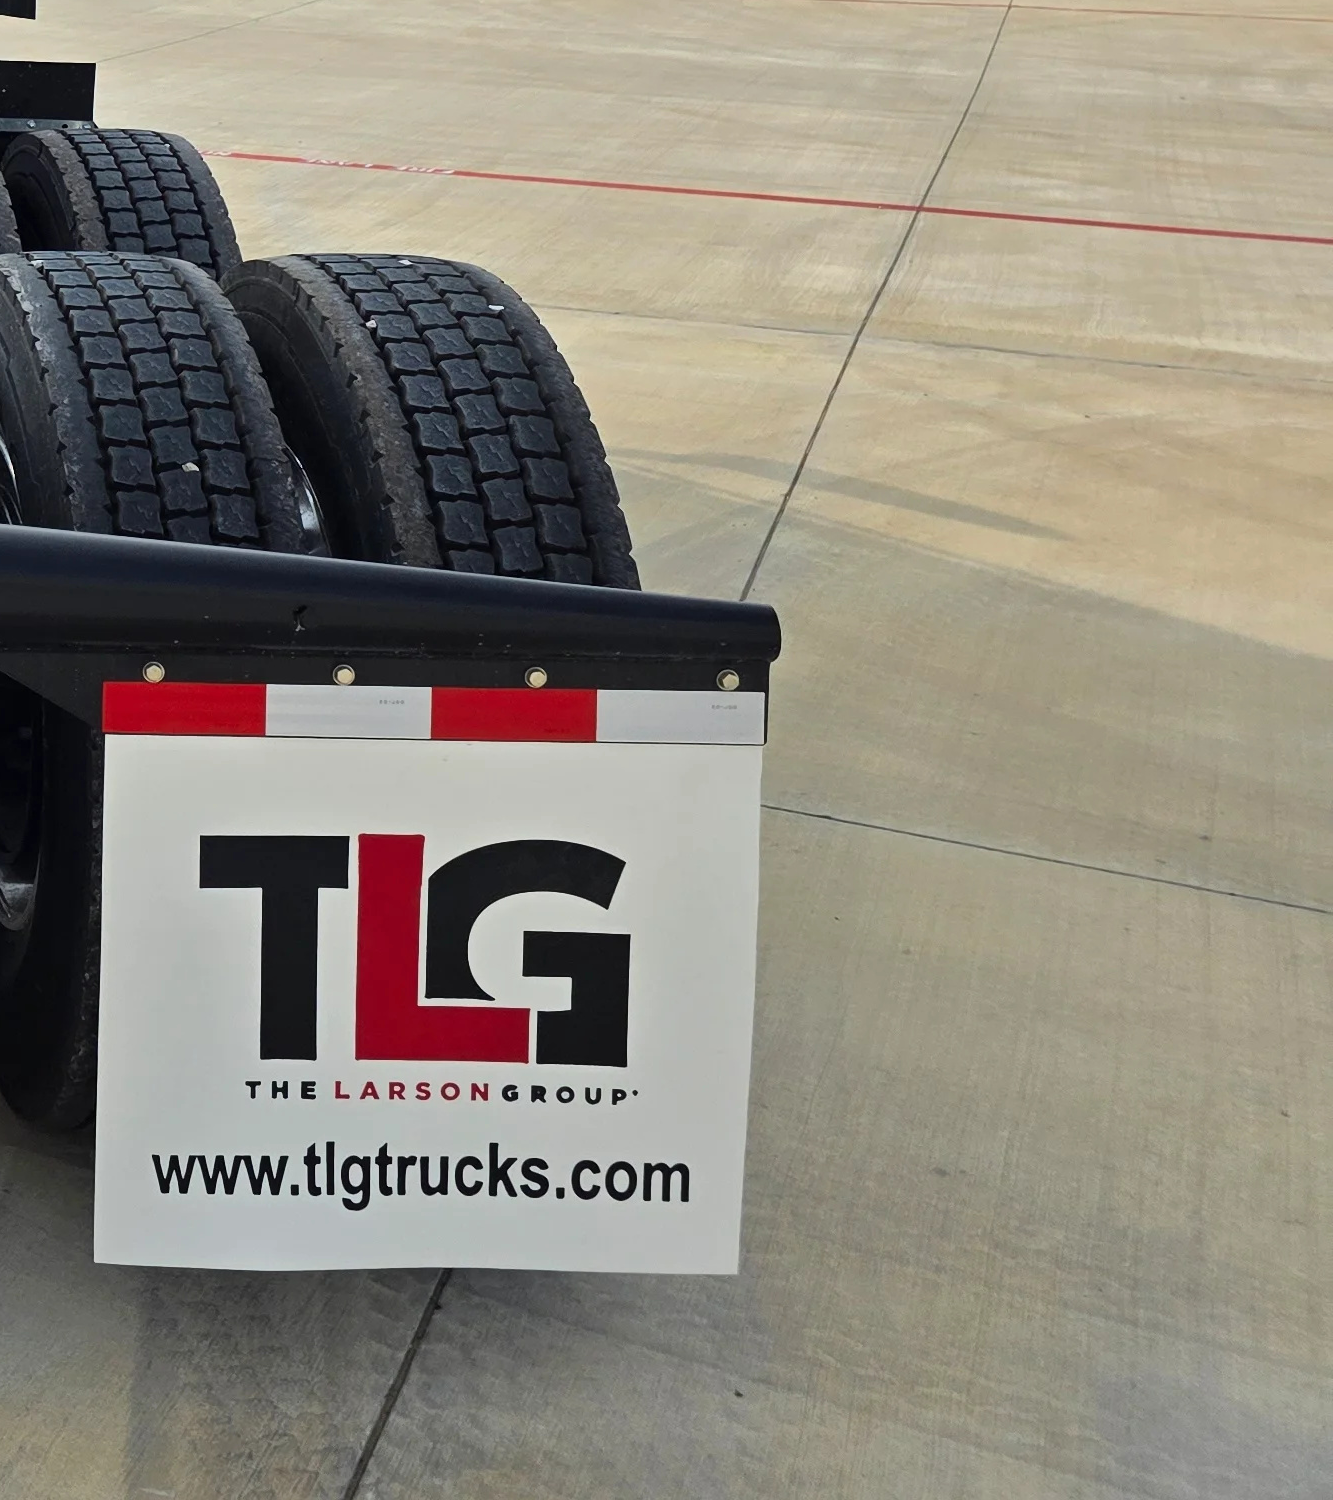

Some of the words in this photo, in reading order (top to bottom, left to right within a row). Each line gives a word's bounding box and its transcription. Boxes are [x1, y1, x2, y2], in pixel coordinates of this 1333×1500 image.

[199, 833, 631, 1068] TLG
[245, 1080, 317, 1101] THE
[151, 1141, 690, 1212] www.tlgtrucks.com
